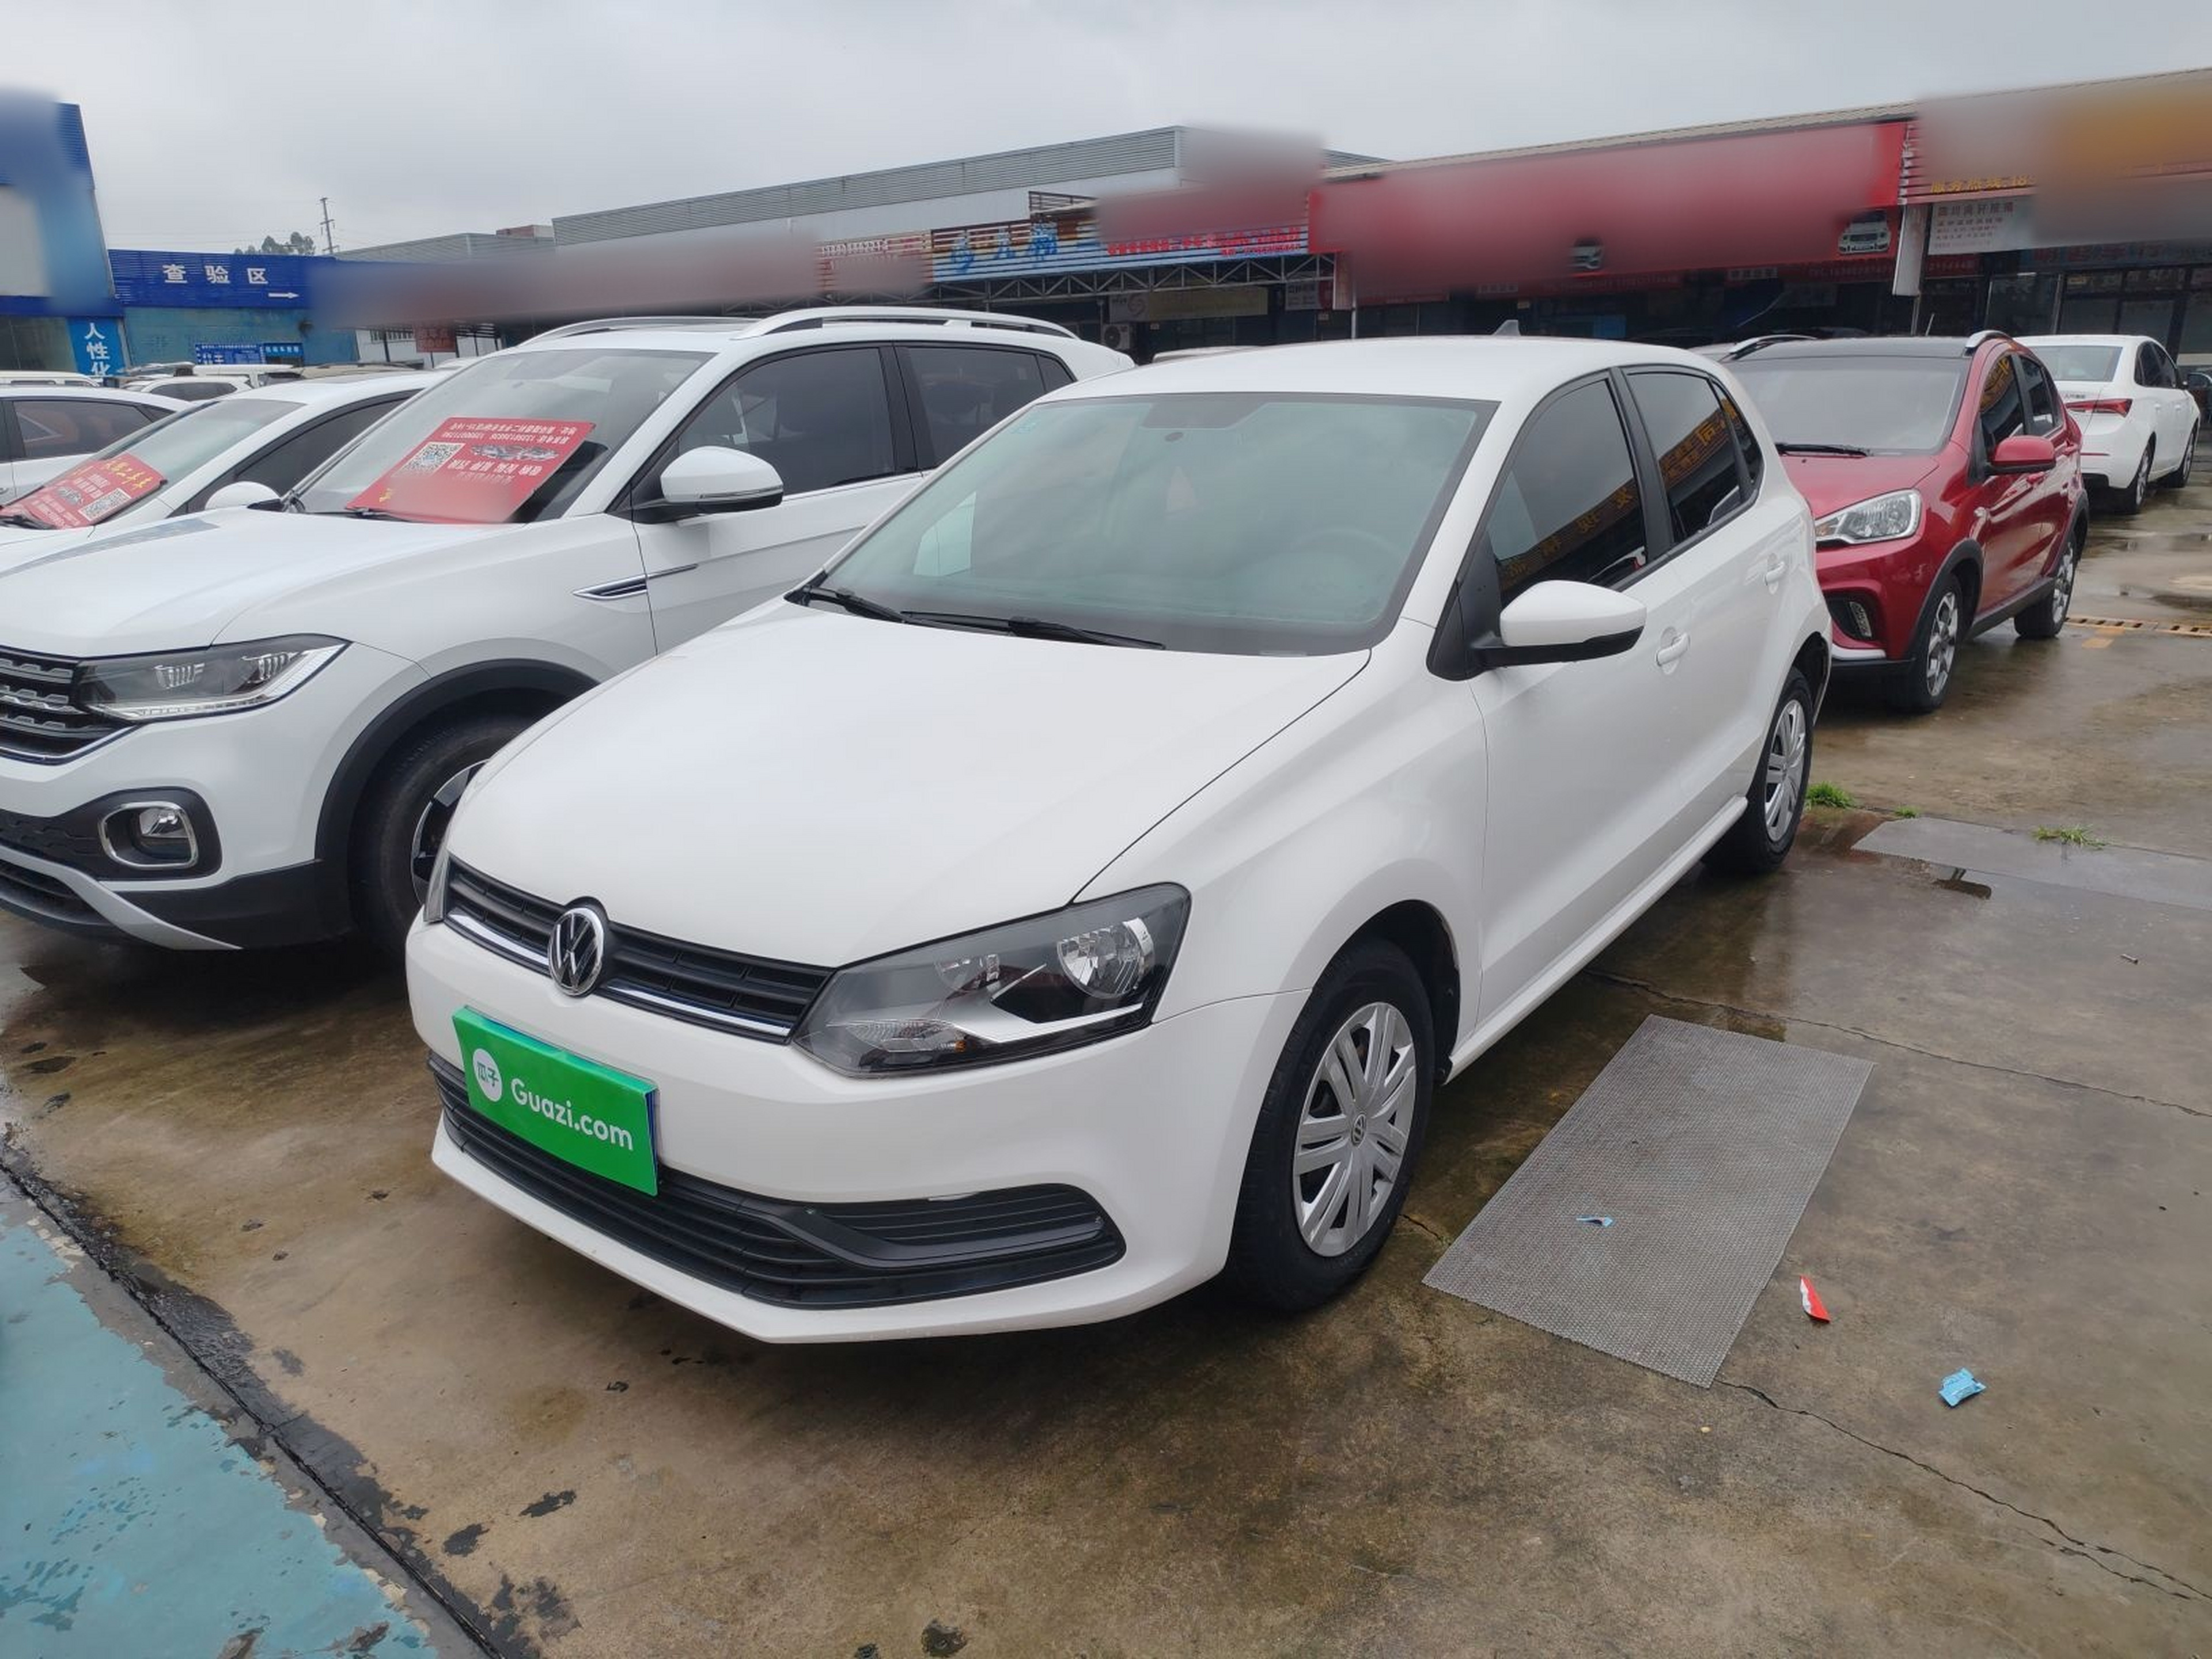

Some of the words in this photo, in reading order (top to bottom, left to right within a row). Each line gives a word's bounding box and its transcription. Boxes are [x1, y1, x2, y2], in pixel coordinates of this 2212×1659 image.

[162, 263, 268, 284] 查验区
[84, 322, 110, 376] 人性化
[511, 1078, 634, 1151] Guazi.com
